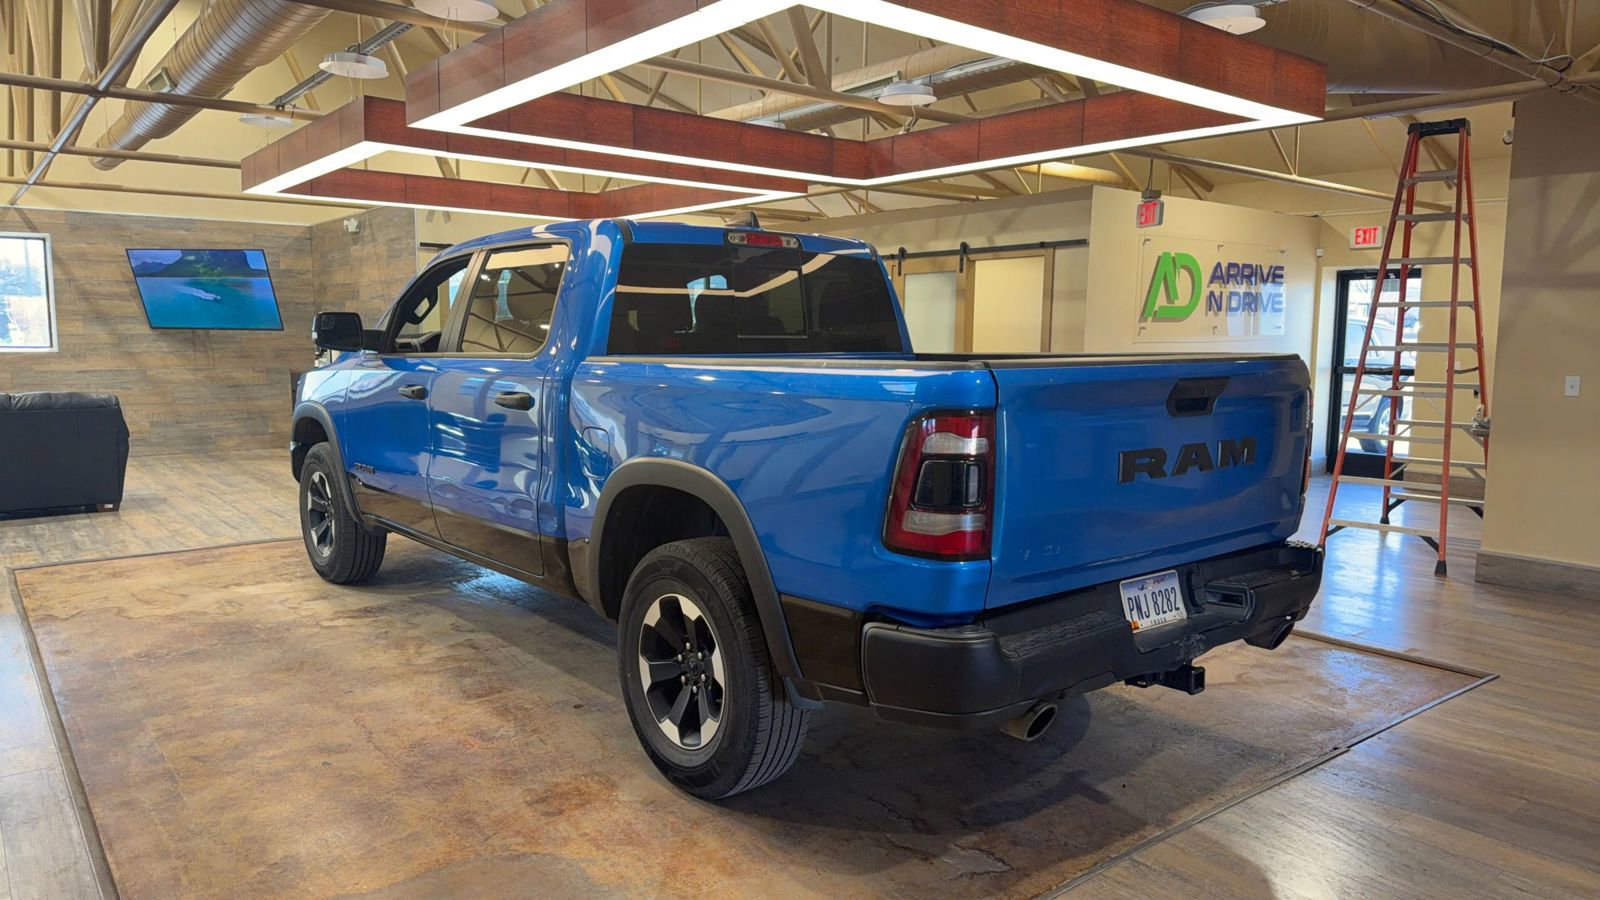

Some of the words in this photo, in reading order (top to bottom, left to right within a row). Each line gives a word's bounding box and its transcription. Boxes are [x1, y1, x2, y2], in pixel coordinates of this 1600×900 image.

[1355, 227, 1377, 244] EXIT
[1208, 261, 1284, 286] ARRIVE
[1208, 290, 1223, 312] N
[1228, 291, 1283, 313] DRIVE
[1118, 437, 1256, 484] RAM
[1127, 593, 1150, 621] PNJ
[1151, 586, 1180, 616] 8282
